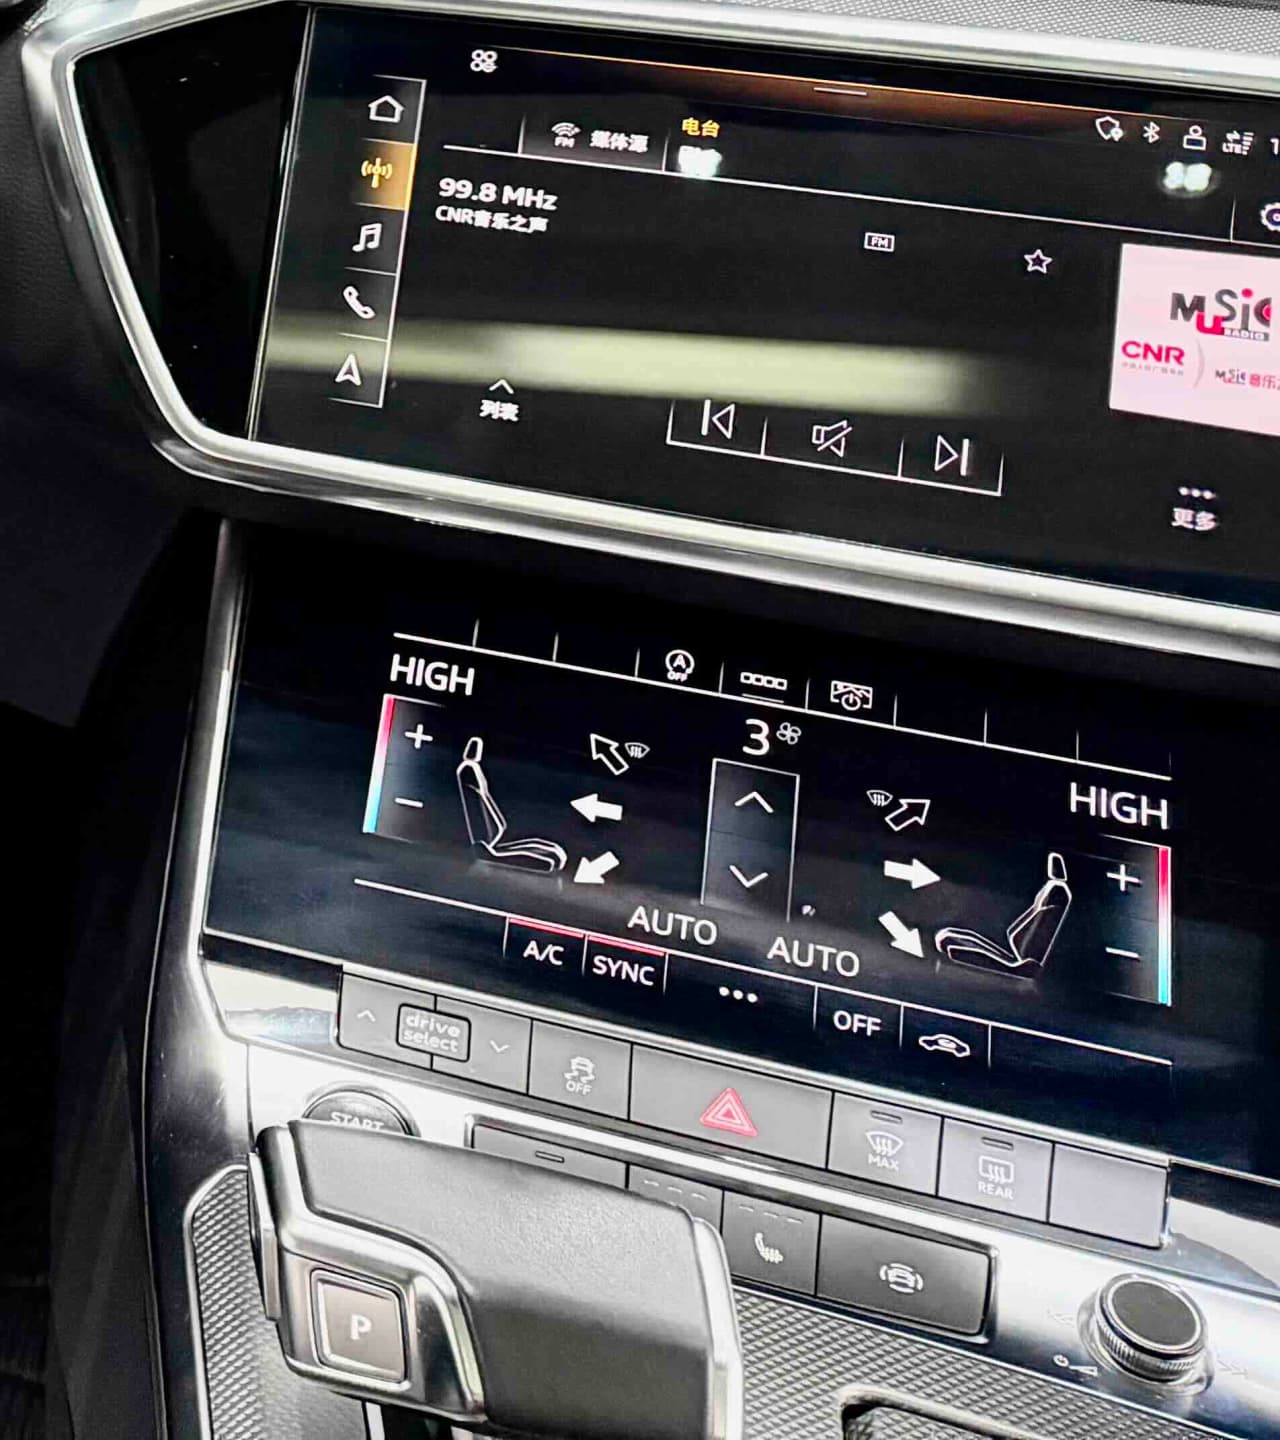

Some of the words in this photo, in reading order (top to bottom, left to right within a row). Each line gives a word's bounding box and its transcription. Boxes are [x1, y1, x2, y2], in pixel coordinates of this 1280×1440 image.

[681, 117, 721, 138] 电台
[554, 137, 576, 149] FM
[590, 130, 649, 154] 媒体源
[438, 177, 497, 202] 99.8
[501, 185, 558, 211] MHz
[435, 205, 549, 233] CNR音乐之声
[1122, 341, 1185, 366] CNR
[480, 399, 519, 422] 列表
[1171, 507, 1217, 531] 更多
[389, 654, 475, 696] HIGH
[667, 670, 688, 682] OFF
[742, 718, 771, 756] 3
[1069, 781, 1169, 830] HIGH
[627, 905, 718, 946] AUTO
[522, 940, 565, 967] A/C
[766, 936, 861, 978] AUTO
[592, 955, 655, 987] SYNC
[405, 1015, 462, 1038] drive
[833, 1009, 882, 1037] OFF
[402, 1028, 460, 1053] select
[565, 1081, 592, 1096] OFF
[328, 1111, 385, 1131] START
[868, 1153, 899, 1172] MAX
[977, 1180, 1014, 1201] REAR
[350, 1314, 372, 1341] P
